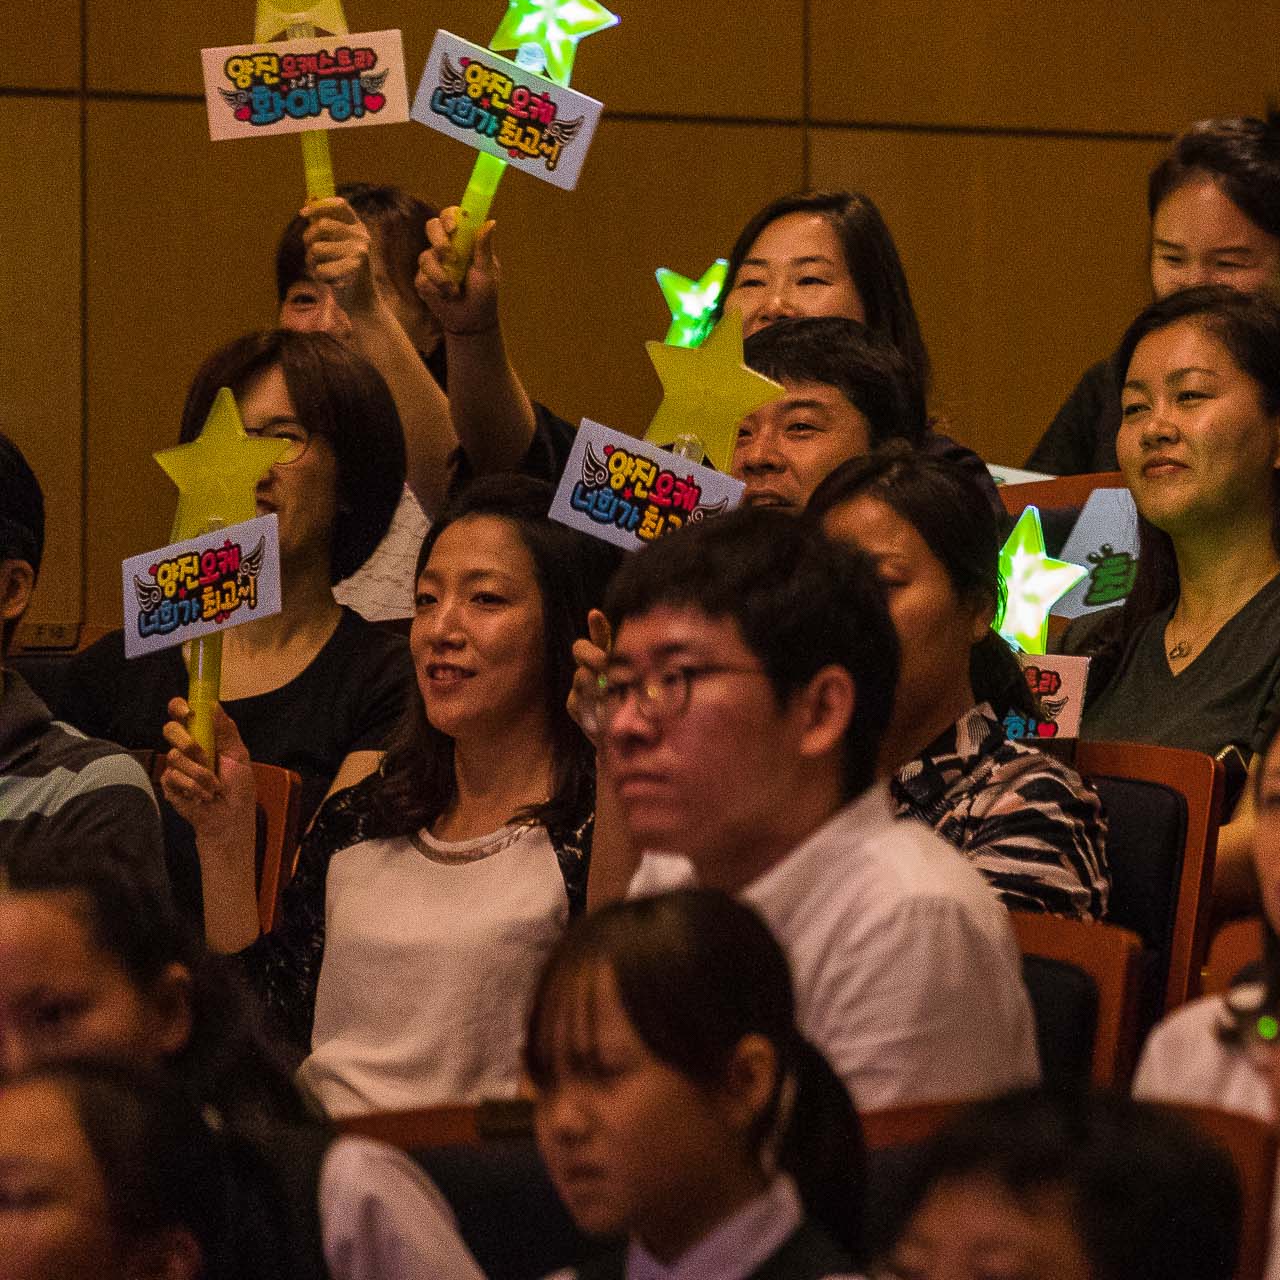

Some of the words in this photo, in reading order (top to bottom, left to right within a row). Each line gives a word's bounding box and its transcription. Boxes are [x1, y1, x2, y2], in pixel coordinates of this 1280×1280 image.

[226, 55, 279, 89] 양진
[280, 49, 375, 79] 오케스트라
[464, 63, 513, 109] 양진
[506, 87, 556, 124] 오케
[431, 88, 498, 137] 너희가
[608, 450, 658, 499] 양진
[648, 472, 700, 511] 오케
[573, 482, 640, 532] 너희가
[157, 555, 200, 598] 양진
[199, 546, 240, 584] 오케
[139, 596, 202, 636] 너희가
